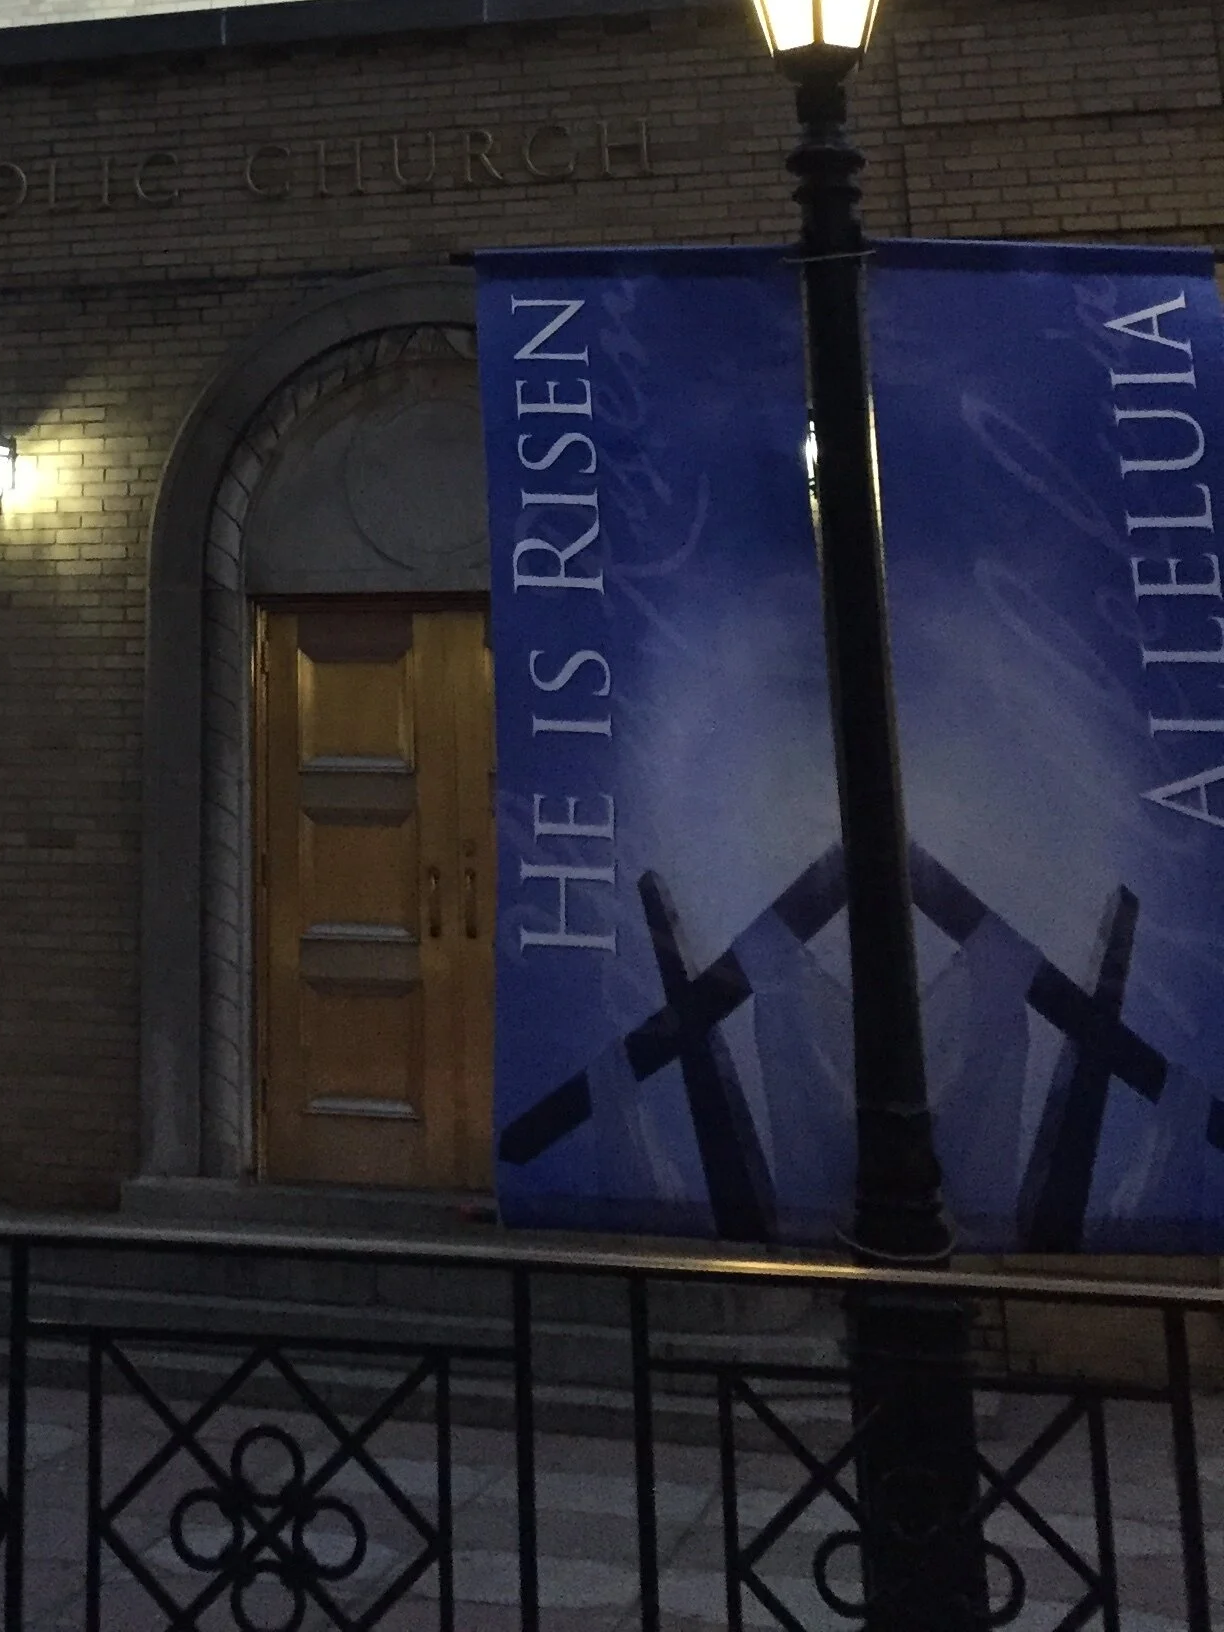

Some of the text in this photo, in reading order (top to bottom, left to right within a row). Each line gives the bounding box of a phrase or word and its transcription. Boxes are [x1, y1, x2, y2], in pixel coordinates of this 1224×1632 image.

[245, 117, 650, 198] CHURCH
[511, 294, 605, 596] RISEN
[529, 649, 613, 739] IS
[520, 792, 617, 957] HE
